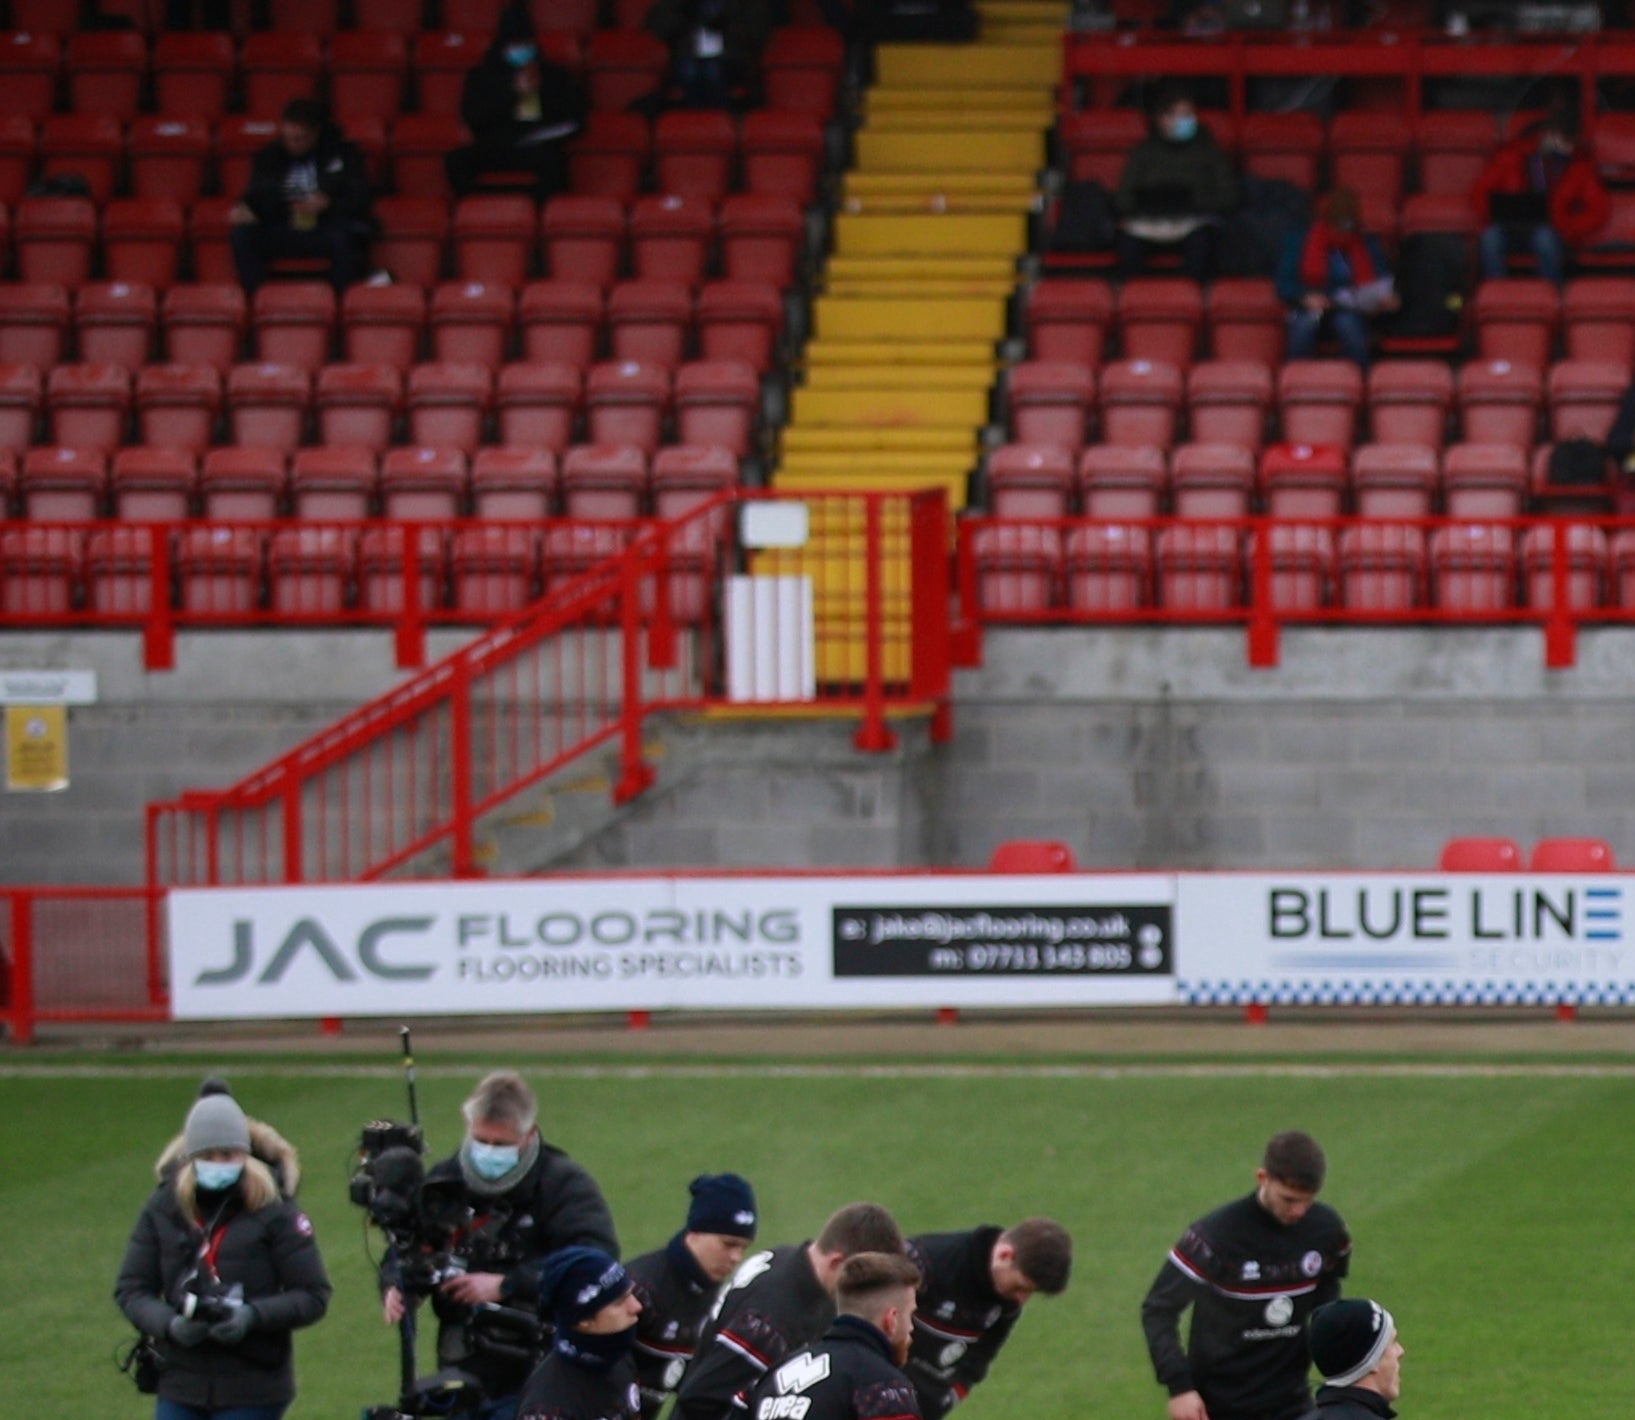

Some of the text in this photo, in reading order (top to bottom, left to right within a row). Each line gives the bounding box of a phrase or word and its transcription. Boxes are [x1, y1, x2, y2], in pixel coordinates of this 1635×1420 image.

[457, 910, 801, 947] FLOORING
[1267, 888, 1623, 940] BLUE LINE
[195, 917, 437, 984] JAC
[457, 952, 804, 981] FLOORING SPECIALISTS
